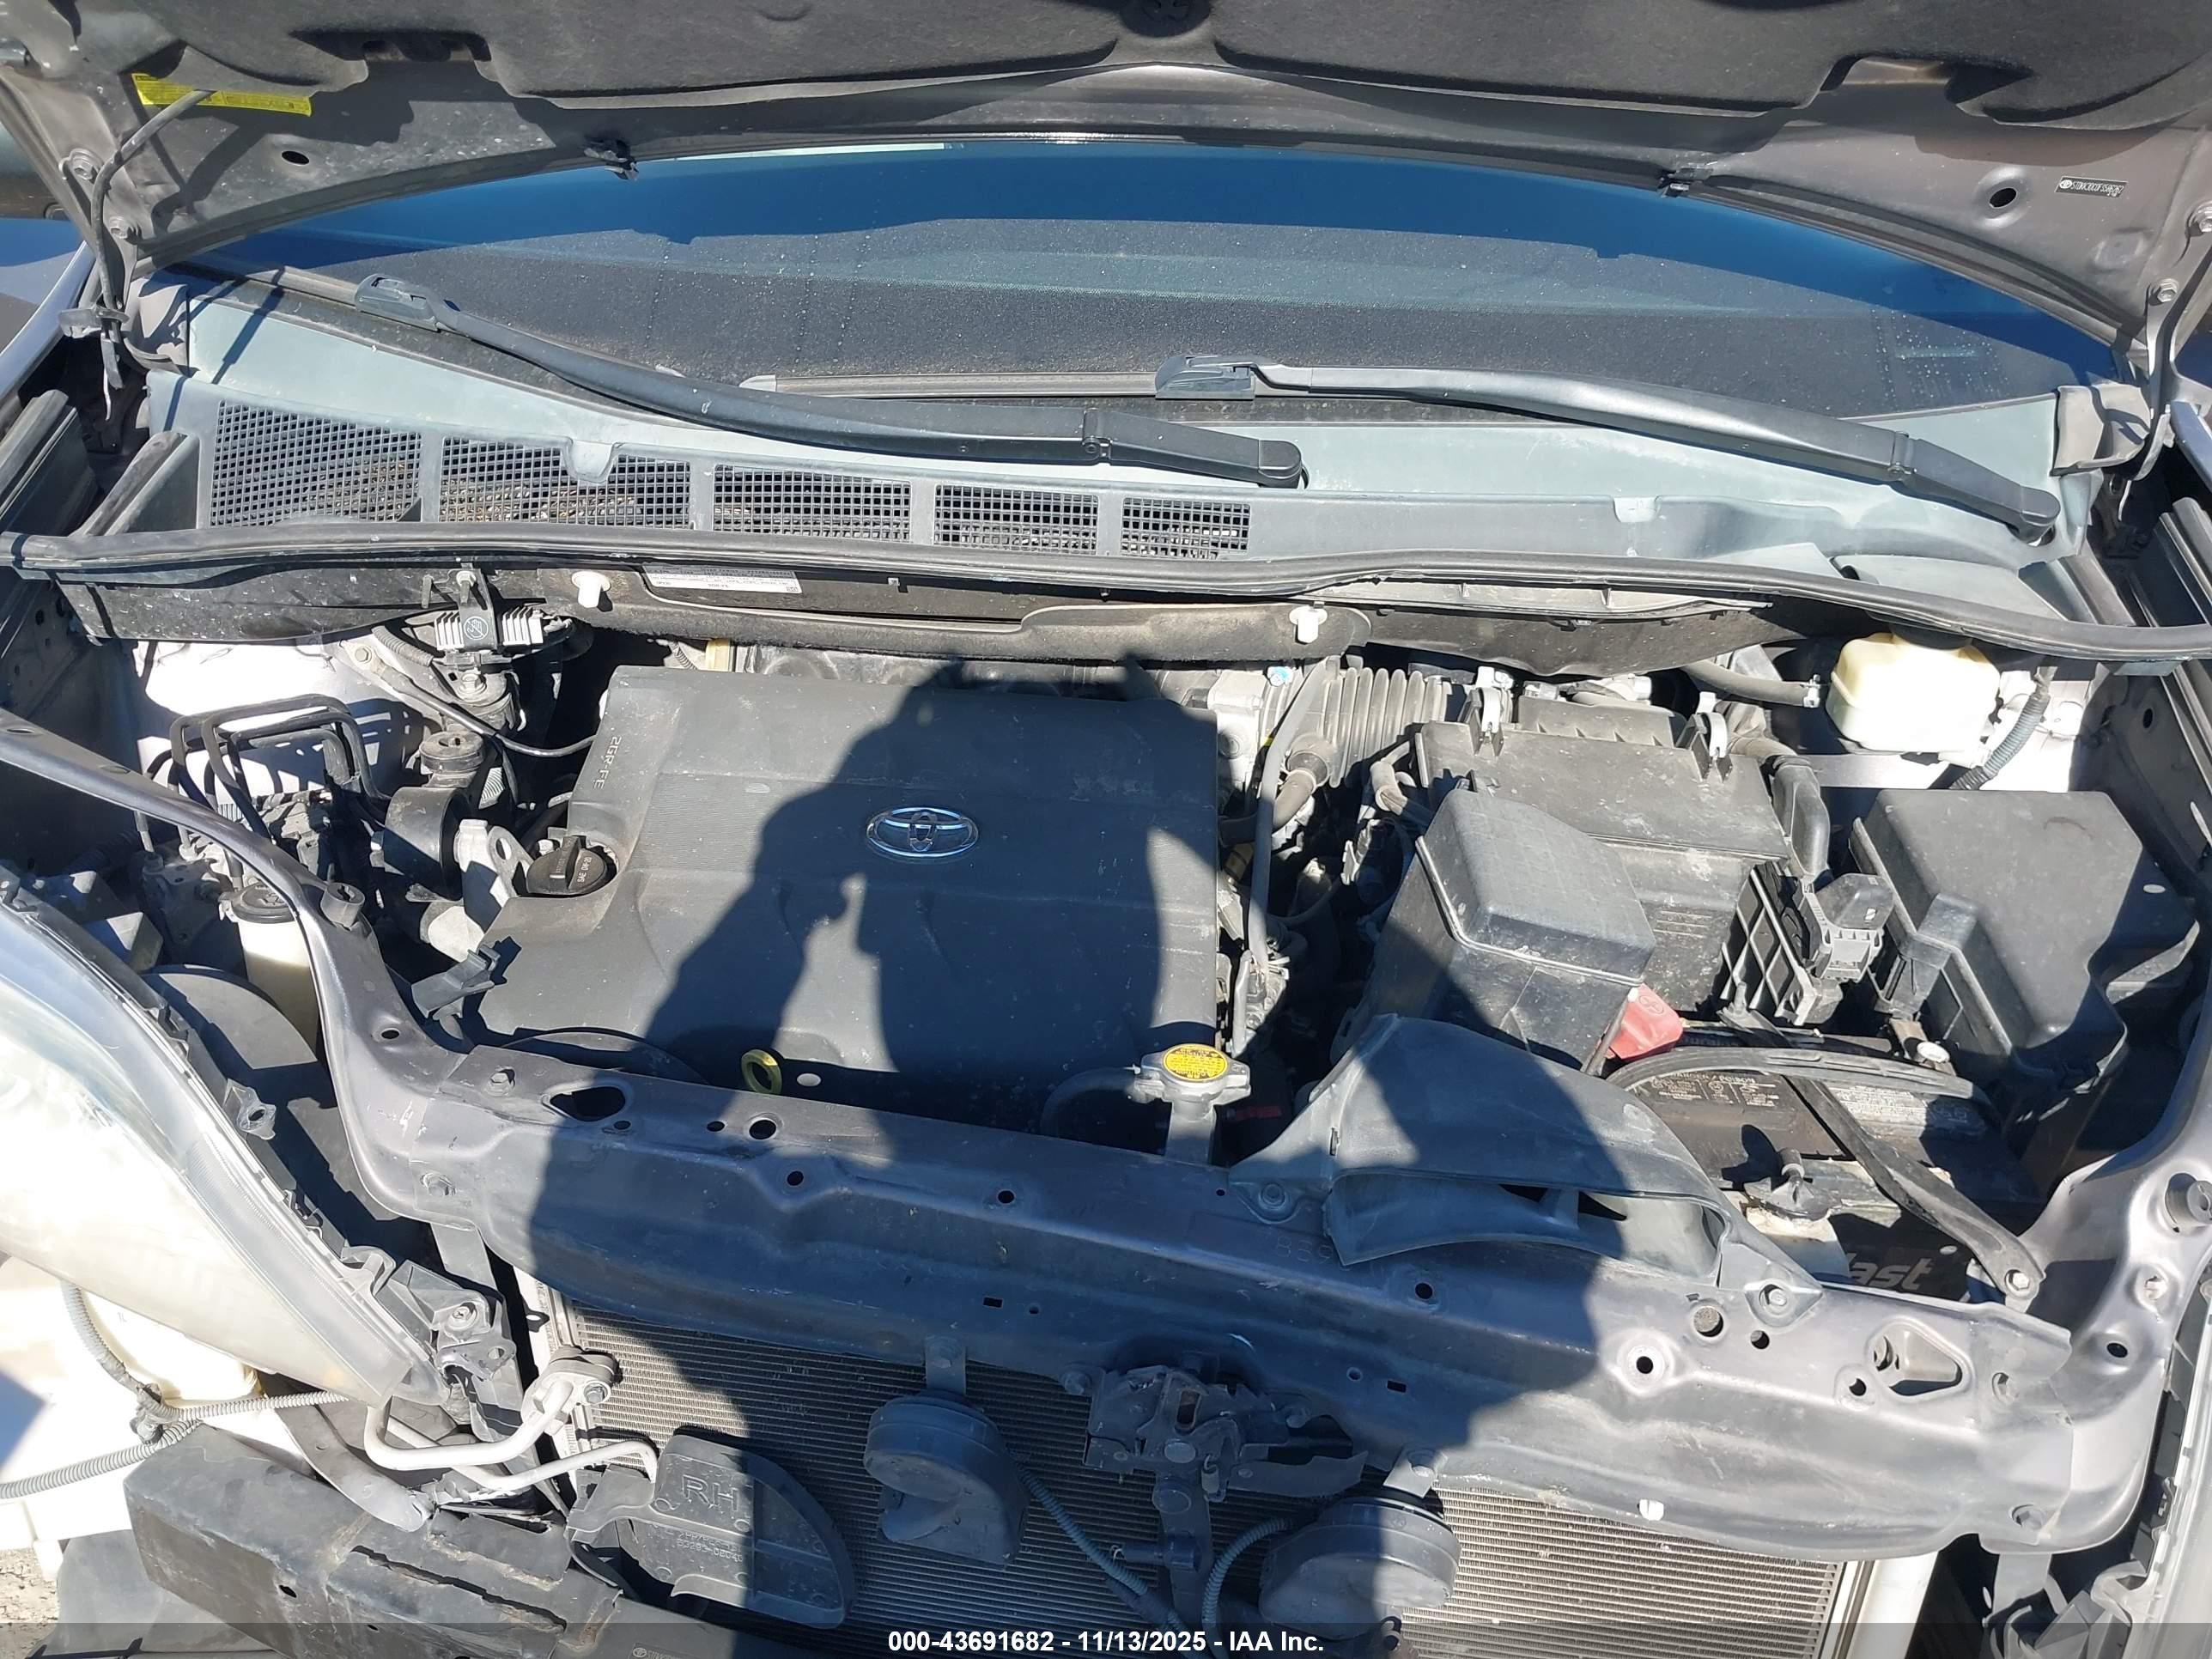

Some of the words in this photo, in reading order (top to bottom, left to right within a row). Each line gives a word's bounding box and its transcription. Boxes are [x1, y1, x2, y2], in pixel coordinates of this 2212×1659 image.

[592, 735, 623, 790] 2GR-FE
[576, 871, 587, 883] SAE
[681, 1474, 739, 1512] RH
